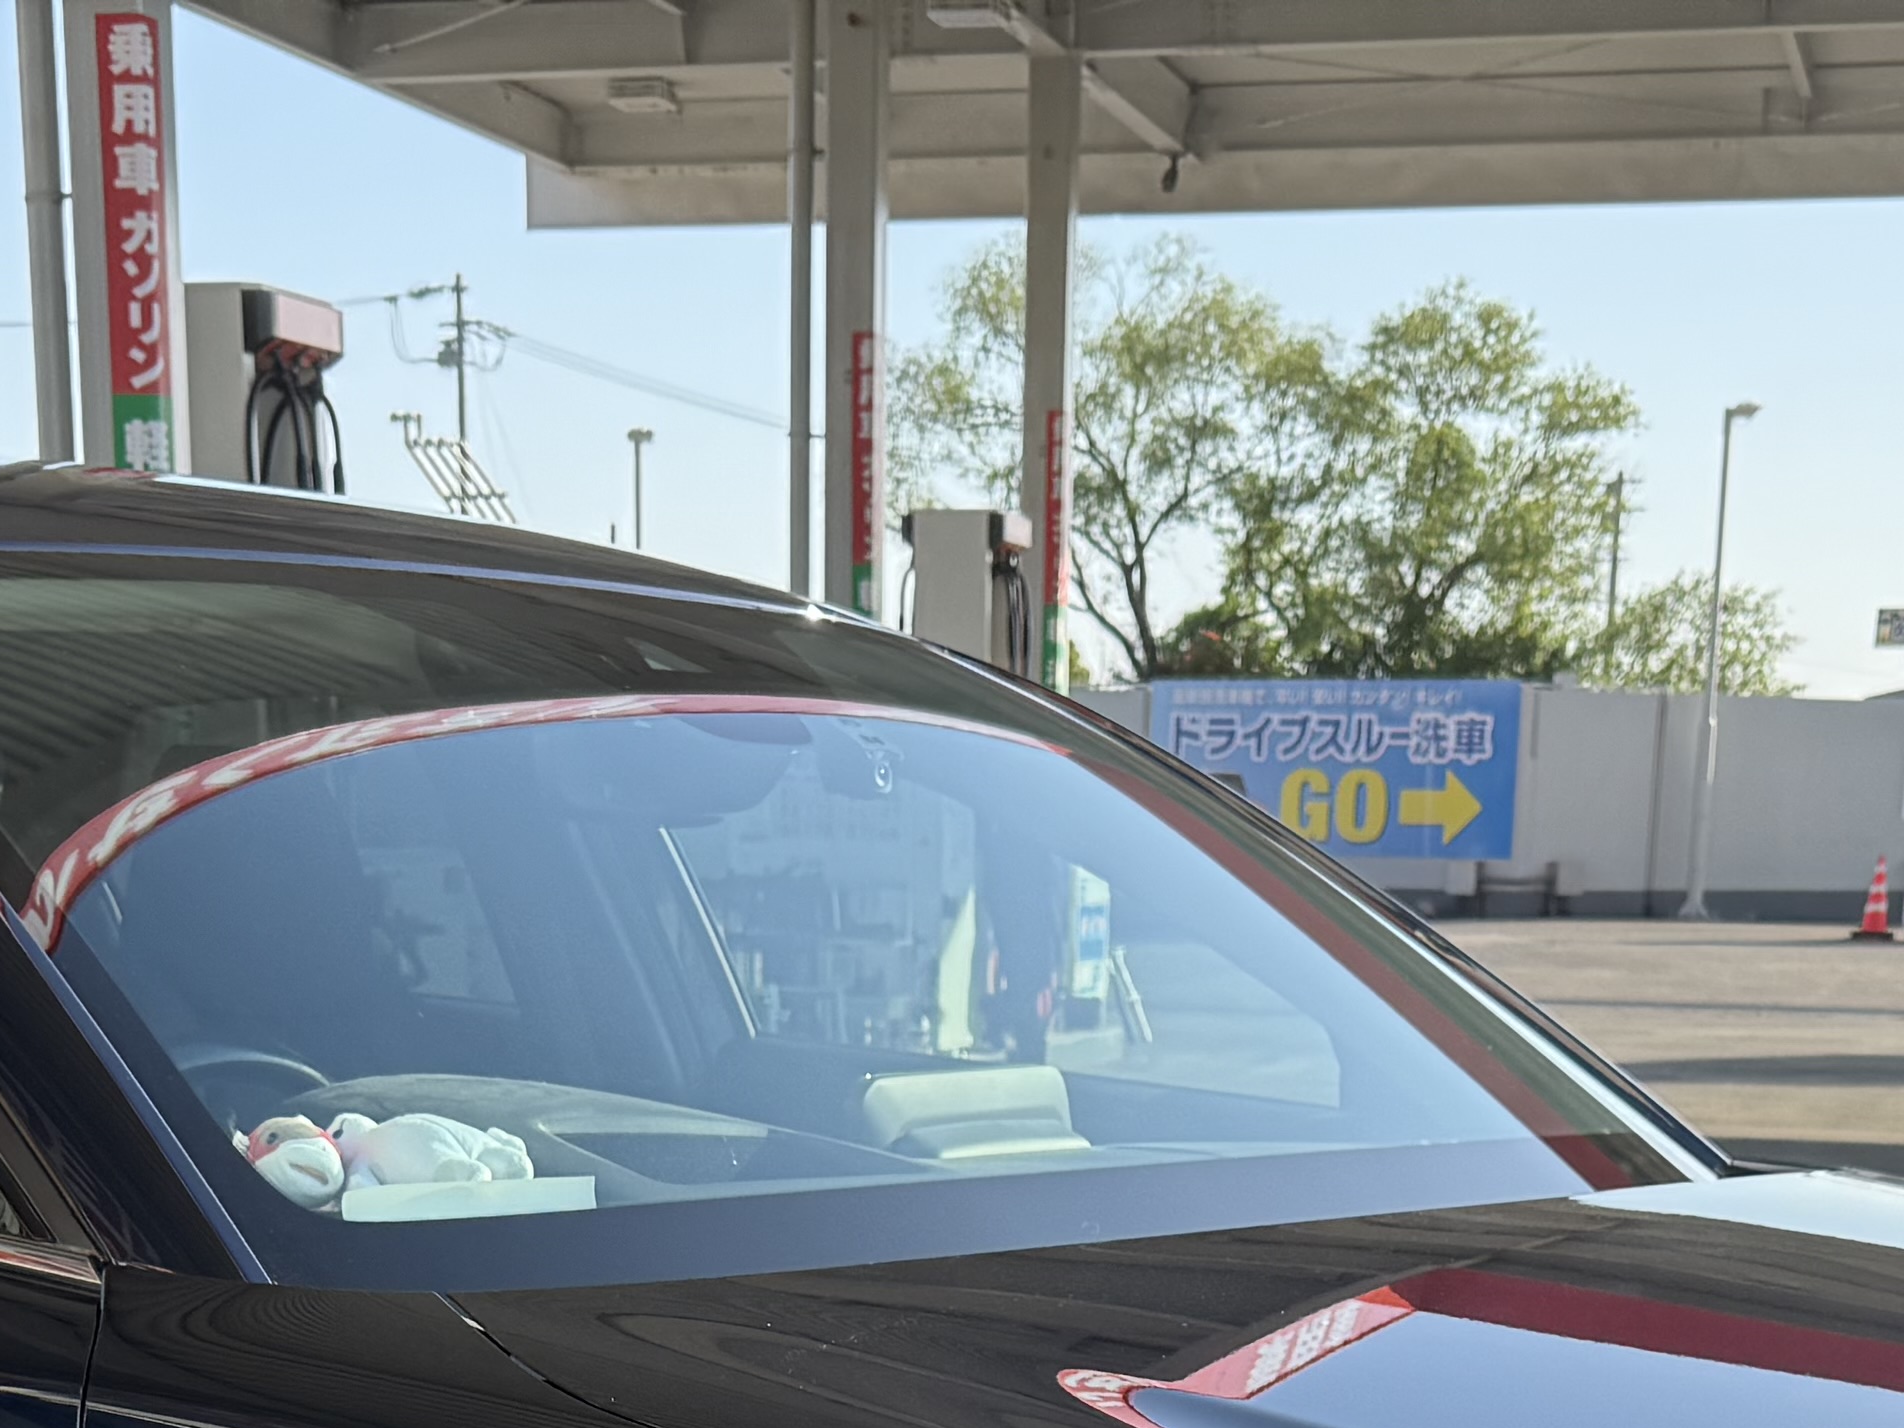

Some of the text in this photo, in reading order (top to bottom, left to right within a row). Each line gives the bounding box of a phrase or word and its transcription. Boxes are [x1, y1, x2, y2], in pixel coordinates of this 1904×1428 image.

[1172, 713, 1492, 763] ドライブスルー洗車
[1280, 768, 1389, 844] GO
